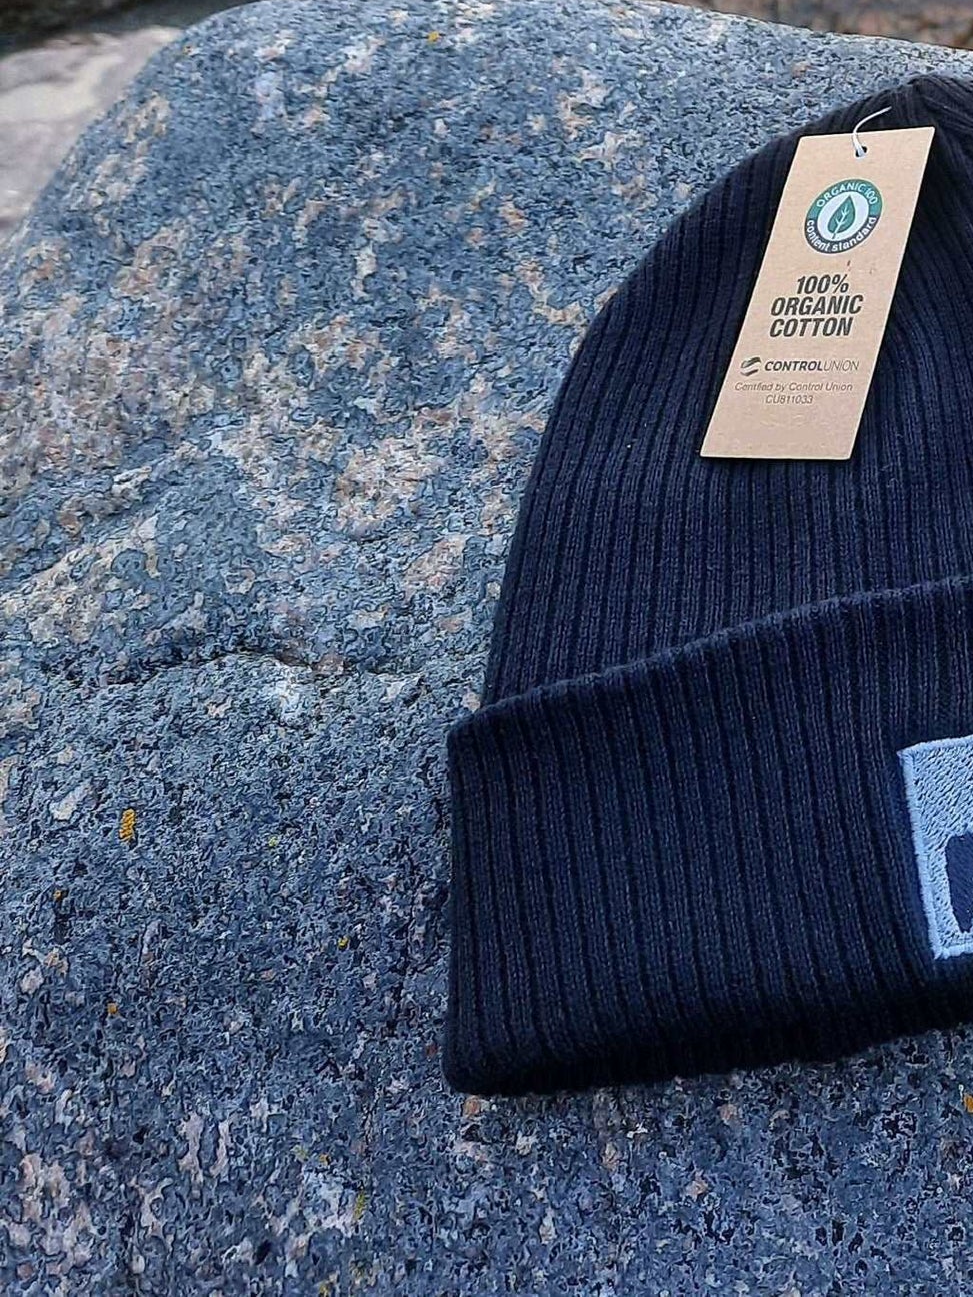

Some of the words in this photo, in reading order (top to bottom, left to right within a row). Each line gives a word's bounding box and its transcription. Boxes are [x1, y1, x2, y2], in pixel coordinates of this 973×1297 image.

[816, 182, 866, 207] ORGANIC
[865, 187, 878, 205] 100
[807, 219, 831, 251] content
[831, 216, 877, 252] standard
[797, 274, 849, 295] 100%
[770, 294, 864, 316] ORGANIC
[769, 317, 854, 337] COTTON
[735, 382, 774, 391] Certified
[775, 382, 786, 392] by
[788, 382, 823, 391] Control
[825, 382, 853, 391] Union
[765, 394, 814, 404] CU811033
